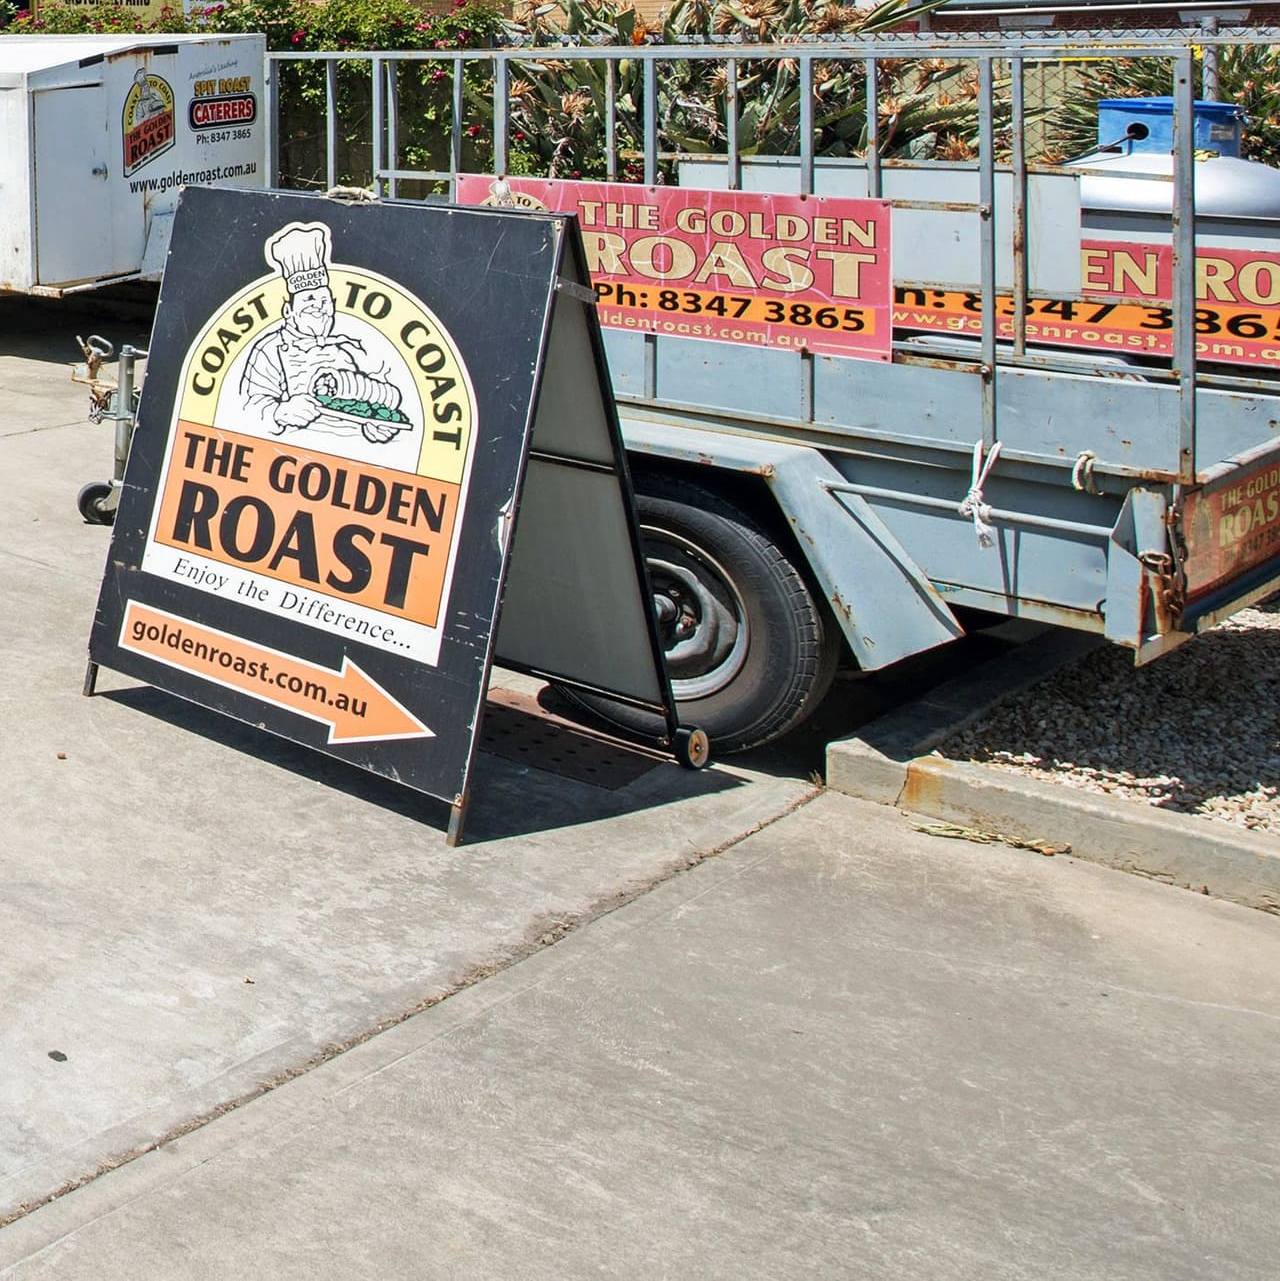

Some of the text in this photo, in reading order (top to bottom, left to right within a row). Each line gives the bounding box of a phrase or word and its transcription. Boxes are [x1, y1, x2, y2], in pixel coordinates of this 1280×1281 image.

[149, 80, 158, 88] TO
[159, 83, 172, 104] COAST
[194, 77, 251, 97] SPIT ROAST
[194, 99, 253, 123] CATERERS
[131, 124, 170, 162] ROAST
[196, 128, 251, 145] Ph: 8347 3865
[130, 162, 256, 193] www.goldenroast.com.au
[517, 196, 531, 207] TO
[577, 200, 877, 248] THE GOLDEN
[290, 270, 325, 284] GOLDEN
[580, 230, 877, 299] ROAST
[294, 278, 322, 290] ROAST
[594, 282, 865, 332] Ph: 8347 3865
[1140, 307, 1280, 340] 386
[598, 310, 807, 348] ldenroast.com.au
[192, 281, 463, 450] COAST TO COAST
[184, 432, 446, 533] THE GOLDEN
[1220, 469, 1280, 511] THE GOLD
[1219, 491, 1280, 548] ROAS
[172, 479, 430, 610] ROAST
[172, 558, 411, 649] Enjoy the Difference...
[132, 620, 367, 718] goldenroast.com.au
